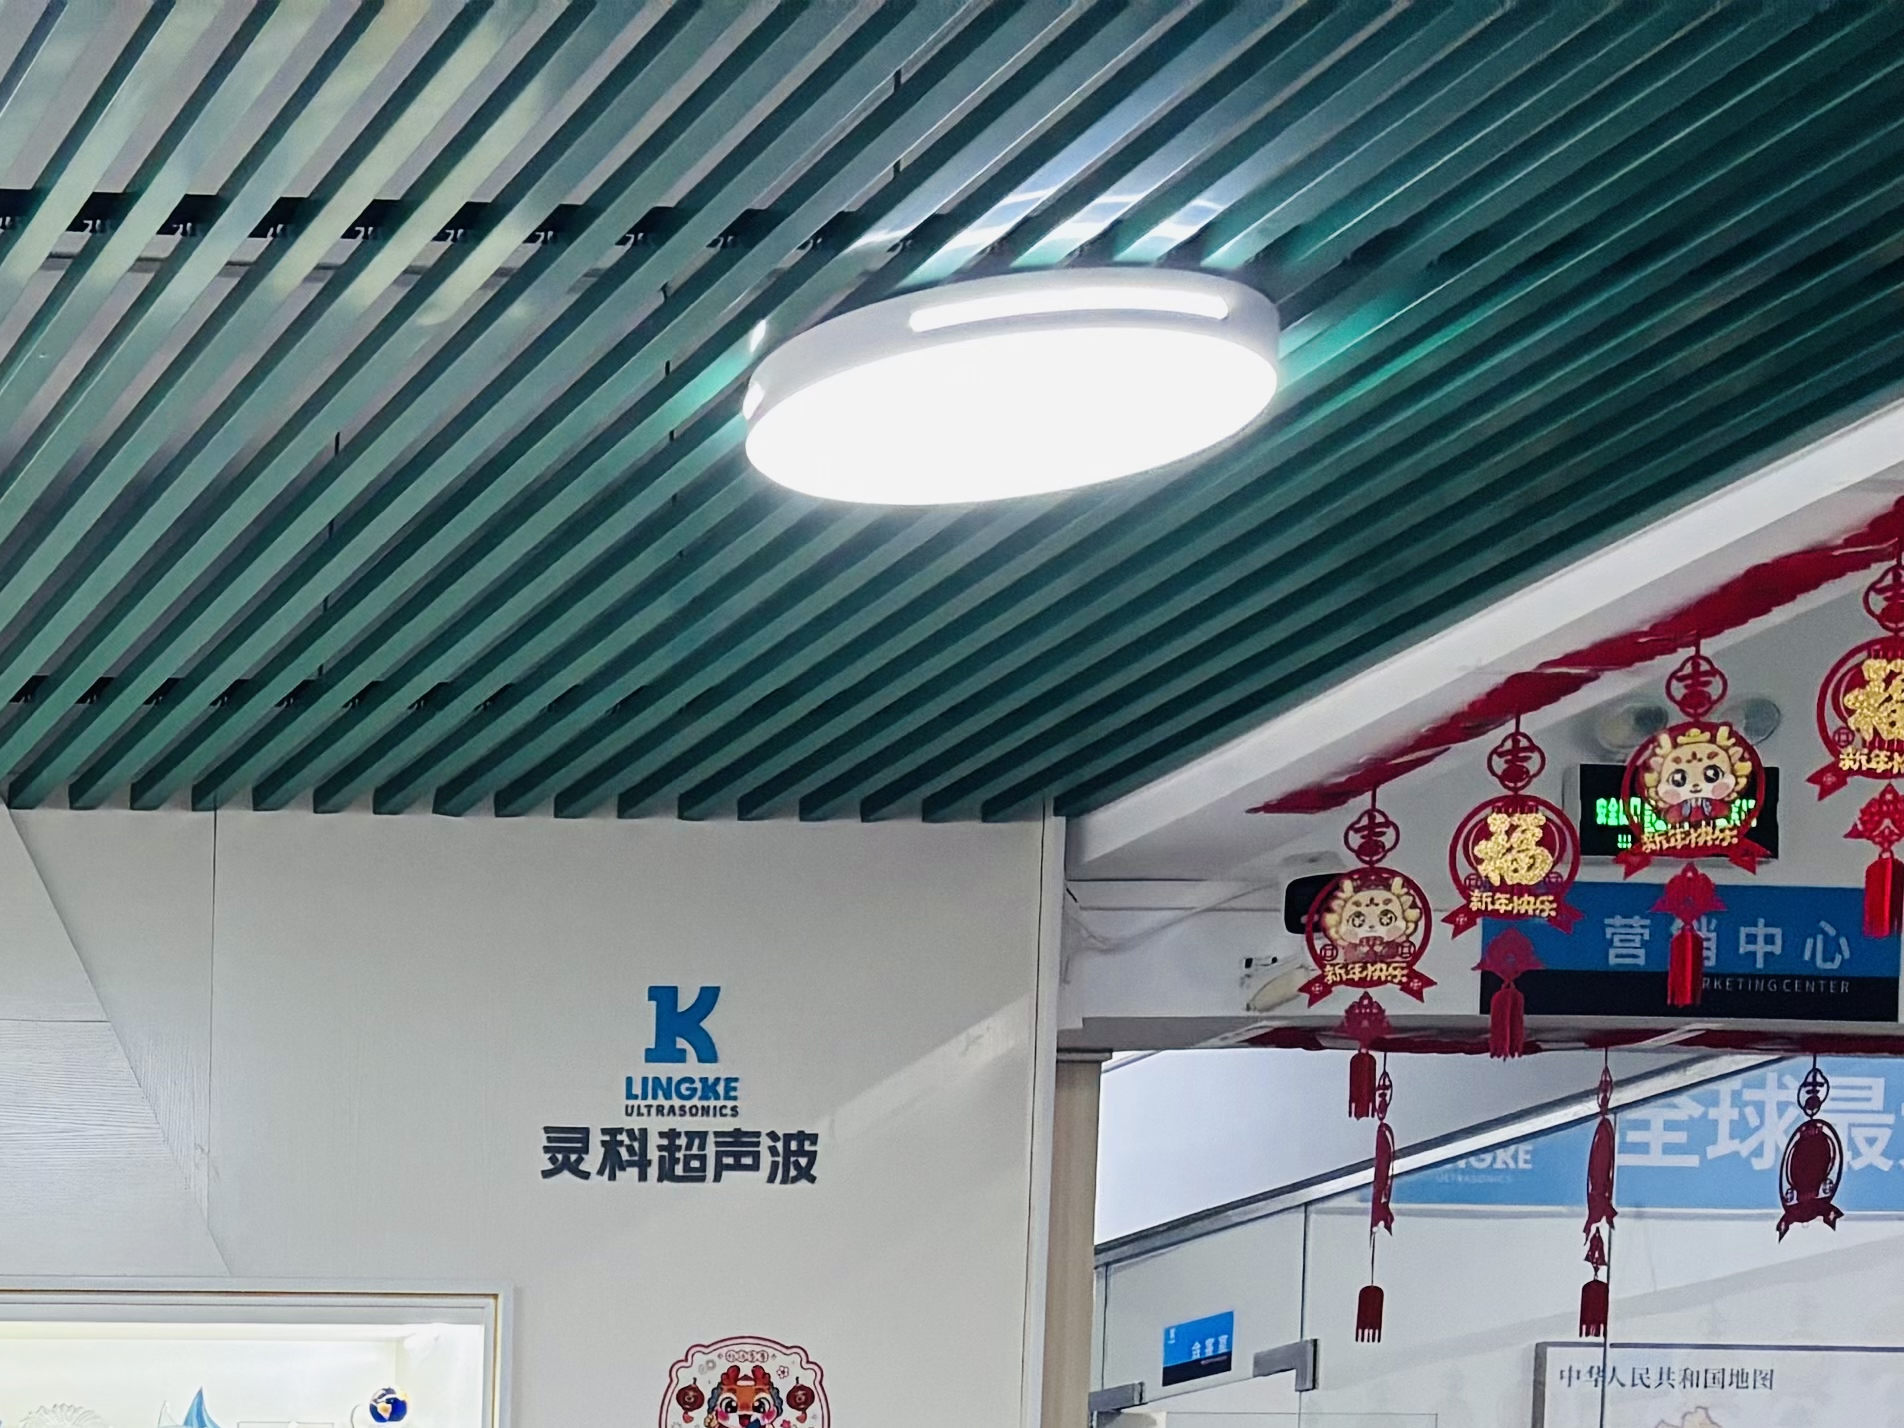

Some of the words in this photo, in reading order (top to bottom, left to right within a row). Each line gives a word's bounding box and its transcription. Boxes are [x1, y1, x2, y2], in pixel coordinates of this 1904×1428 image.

[1474, 813, 1553, 885] 福
[1640, 826, 1739, 852] 新年快乐
[1468, 890, 1557, 918] 新年快乐
[1324, 963, 1408, 984] 新年快乐
[625, 1076, 739, 1101] LINGKE
[625, 1104, 739, 1117] ULTRASONICS
[1614, 1073, 1904, 1172] 全球最
[541, 1126, 818, 1185] 灵科超声波
[1558, 1366, 1775, 1392] 中华人民共和国地图
